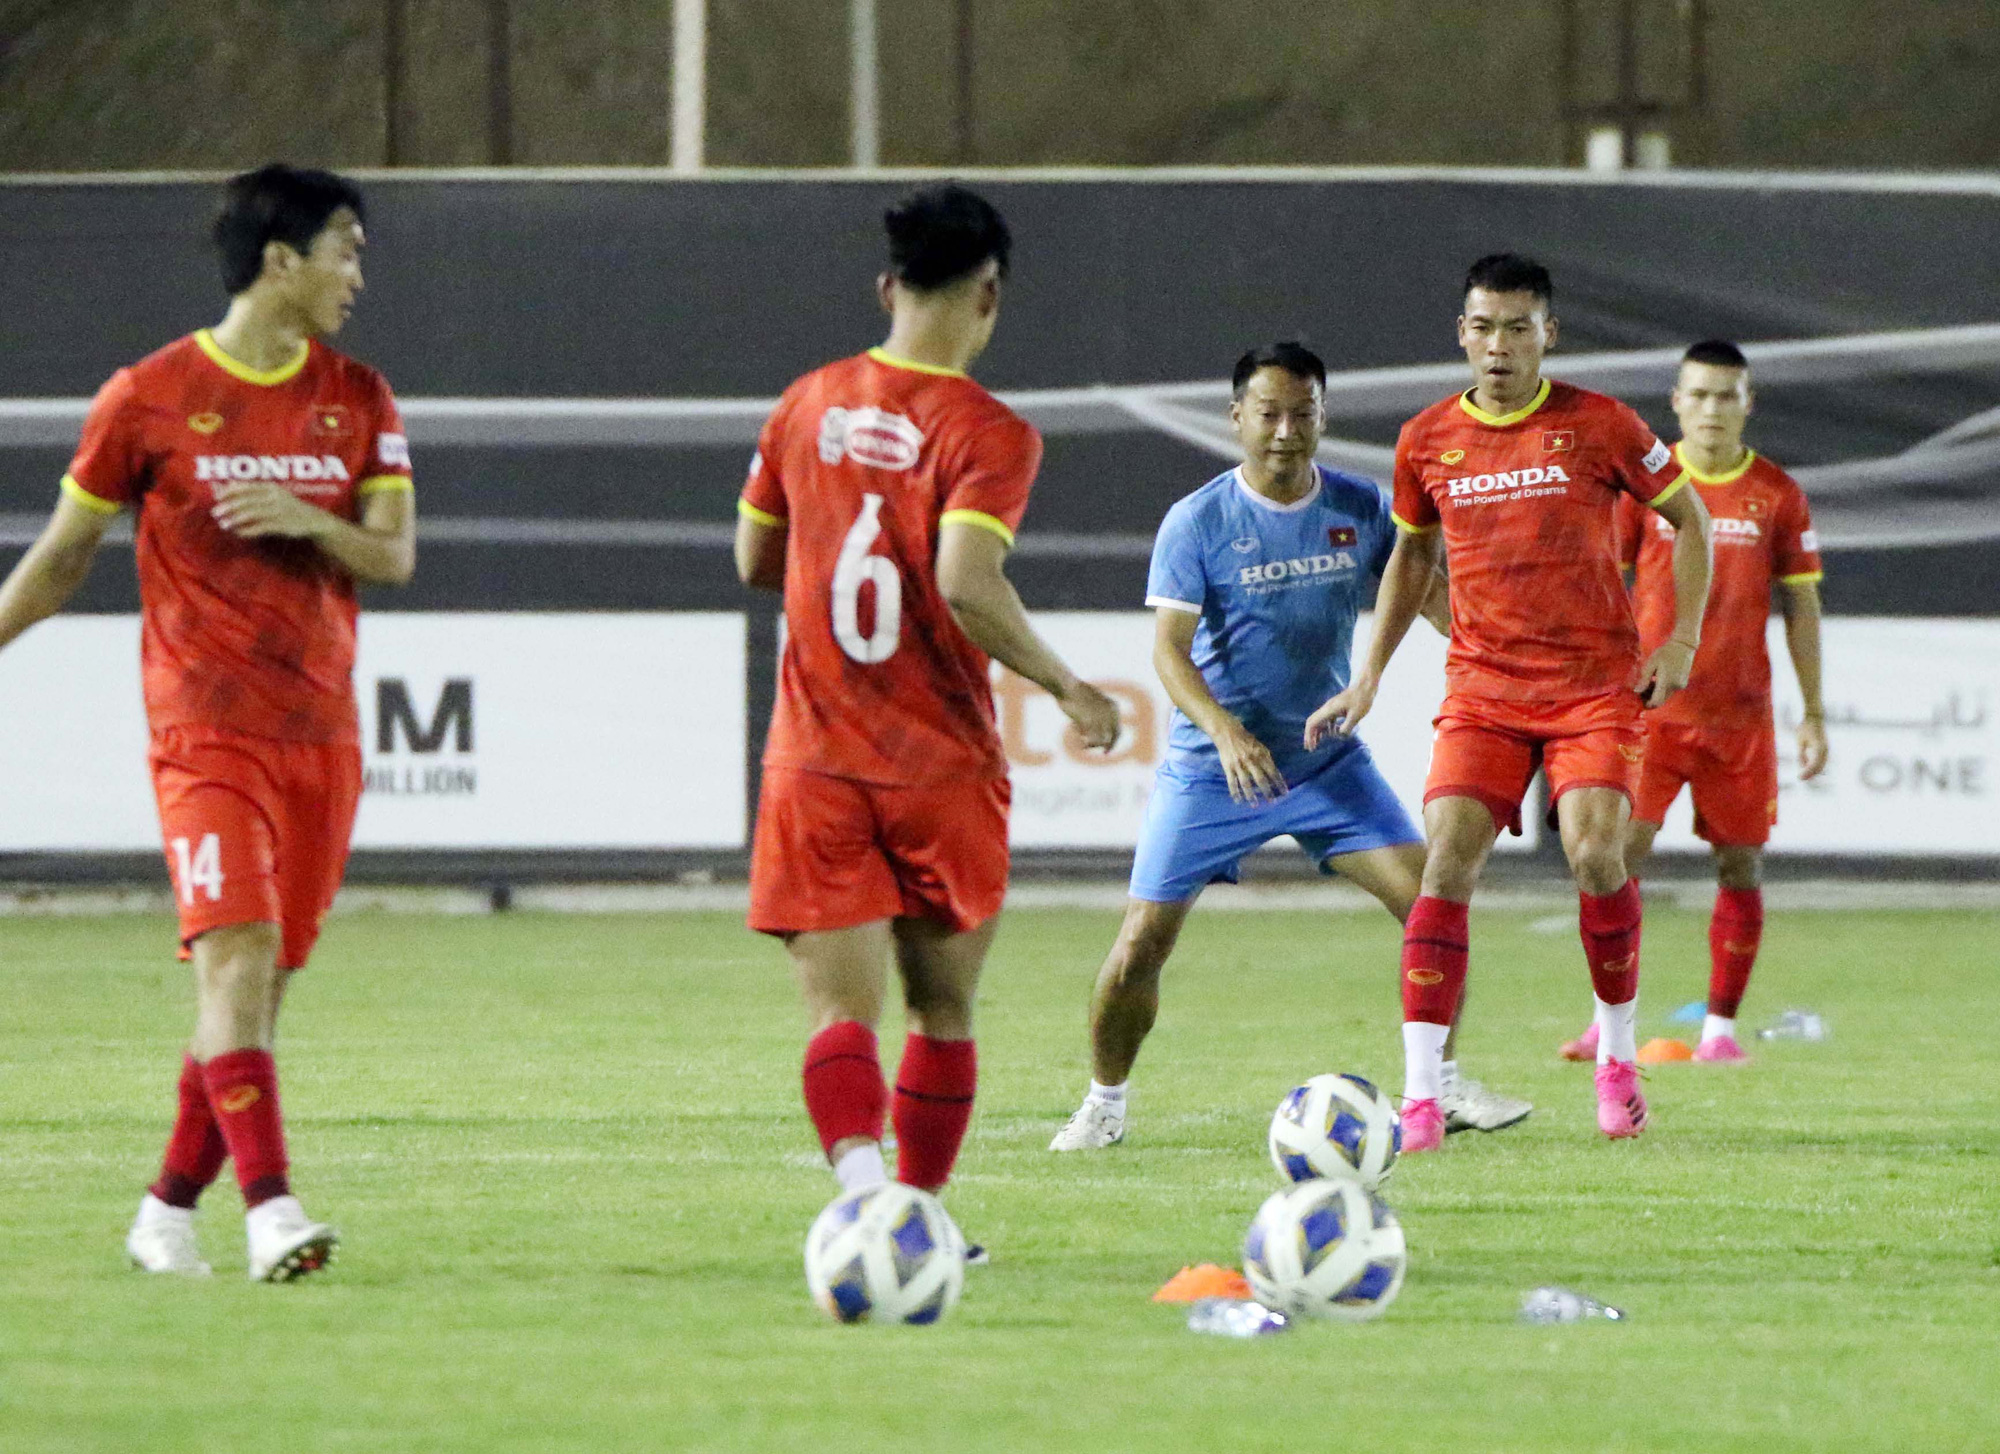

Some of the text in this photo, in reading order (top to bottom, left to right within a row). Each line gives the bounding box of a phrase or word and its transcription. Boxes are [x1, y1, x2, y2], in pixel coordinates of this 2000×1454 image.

[195, 455, 349, 480] HONDA
[1448, 465, 1570, 496] HONDA
[1453, 486, 1567, 507] The Power of Dreams
[831, 493, 901, 664] 6
[1239, 551, 1358, 585] HONDA
[1859, 755, 1988, 794] ONE
[171, 832, 226, 907] 14
